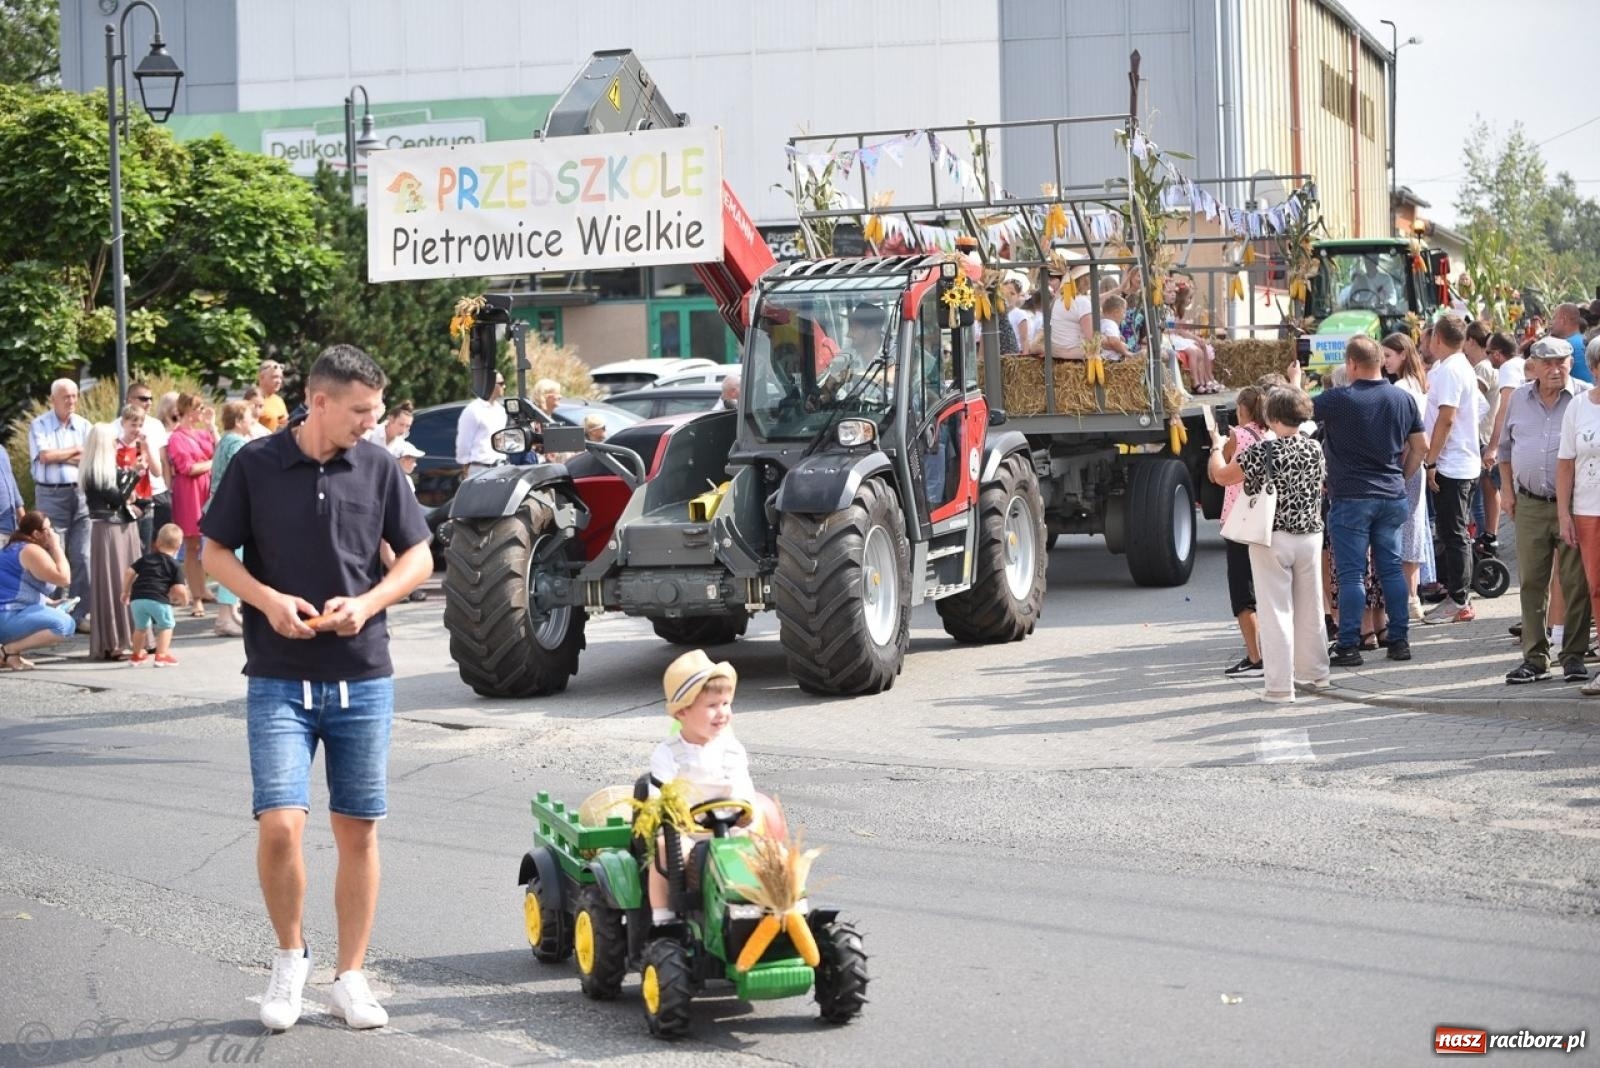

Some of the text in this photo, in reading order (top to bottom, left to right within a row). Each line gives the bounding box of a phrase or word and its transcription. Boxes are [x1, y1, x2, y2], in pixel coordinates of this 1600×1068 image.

[271, 139, 348, 160] Delikat
[436, 147, 705, 212] PRZEDSZKOLE
[392, 209, 705, 266] Pietrowice Wielkie
